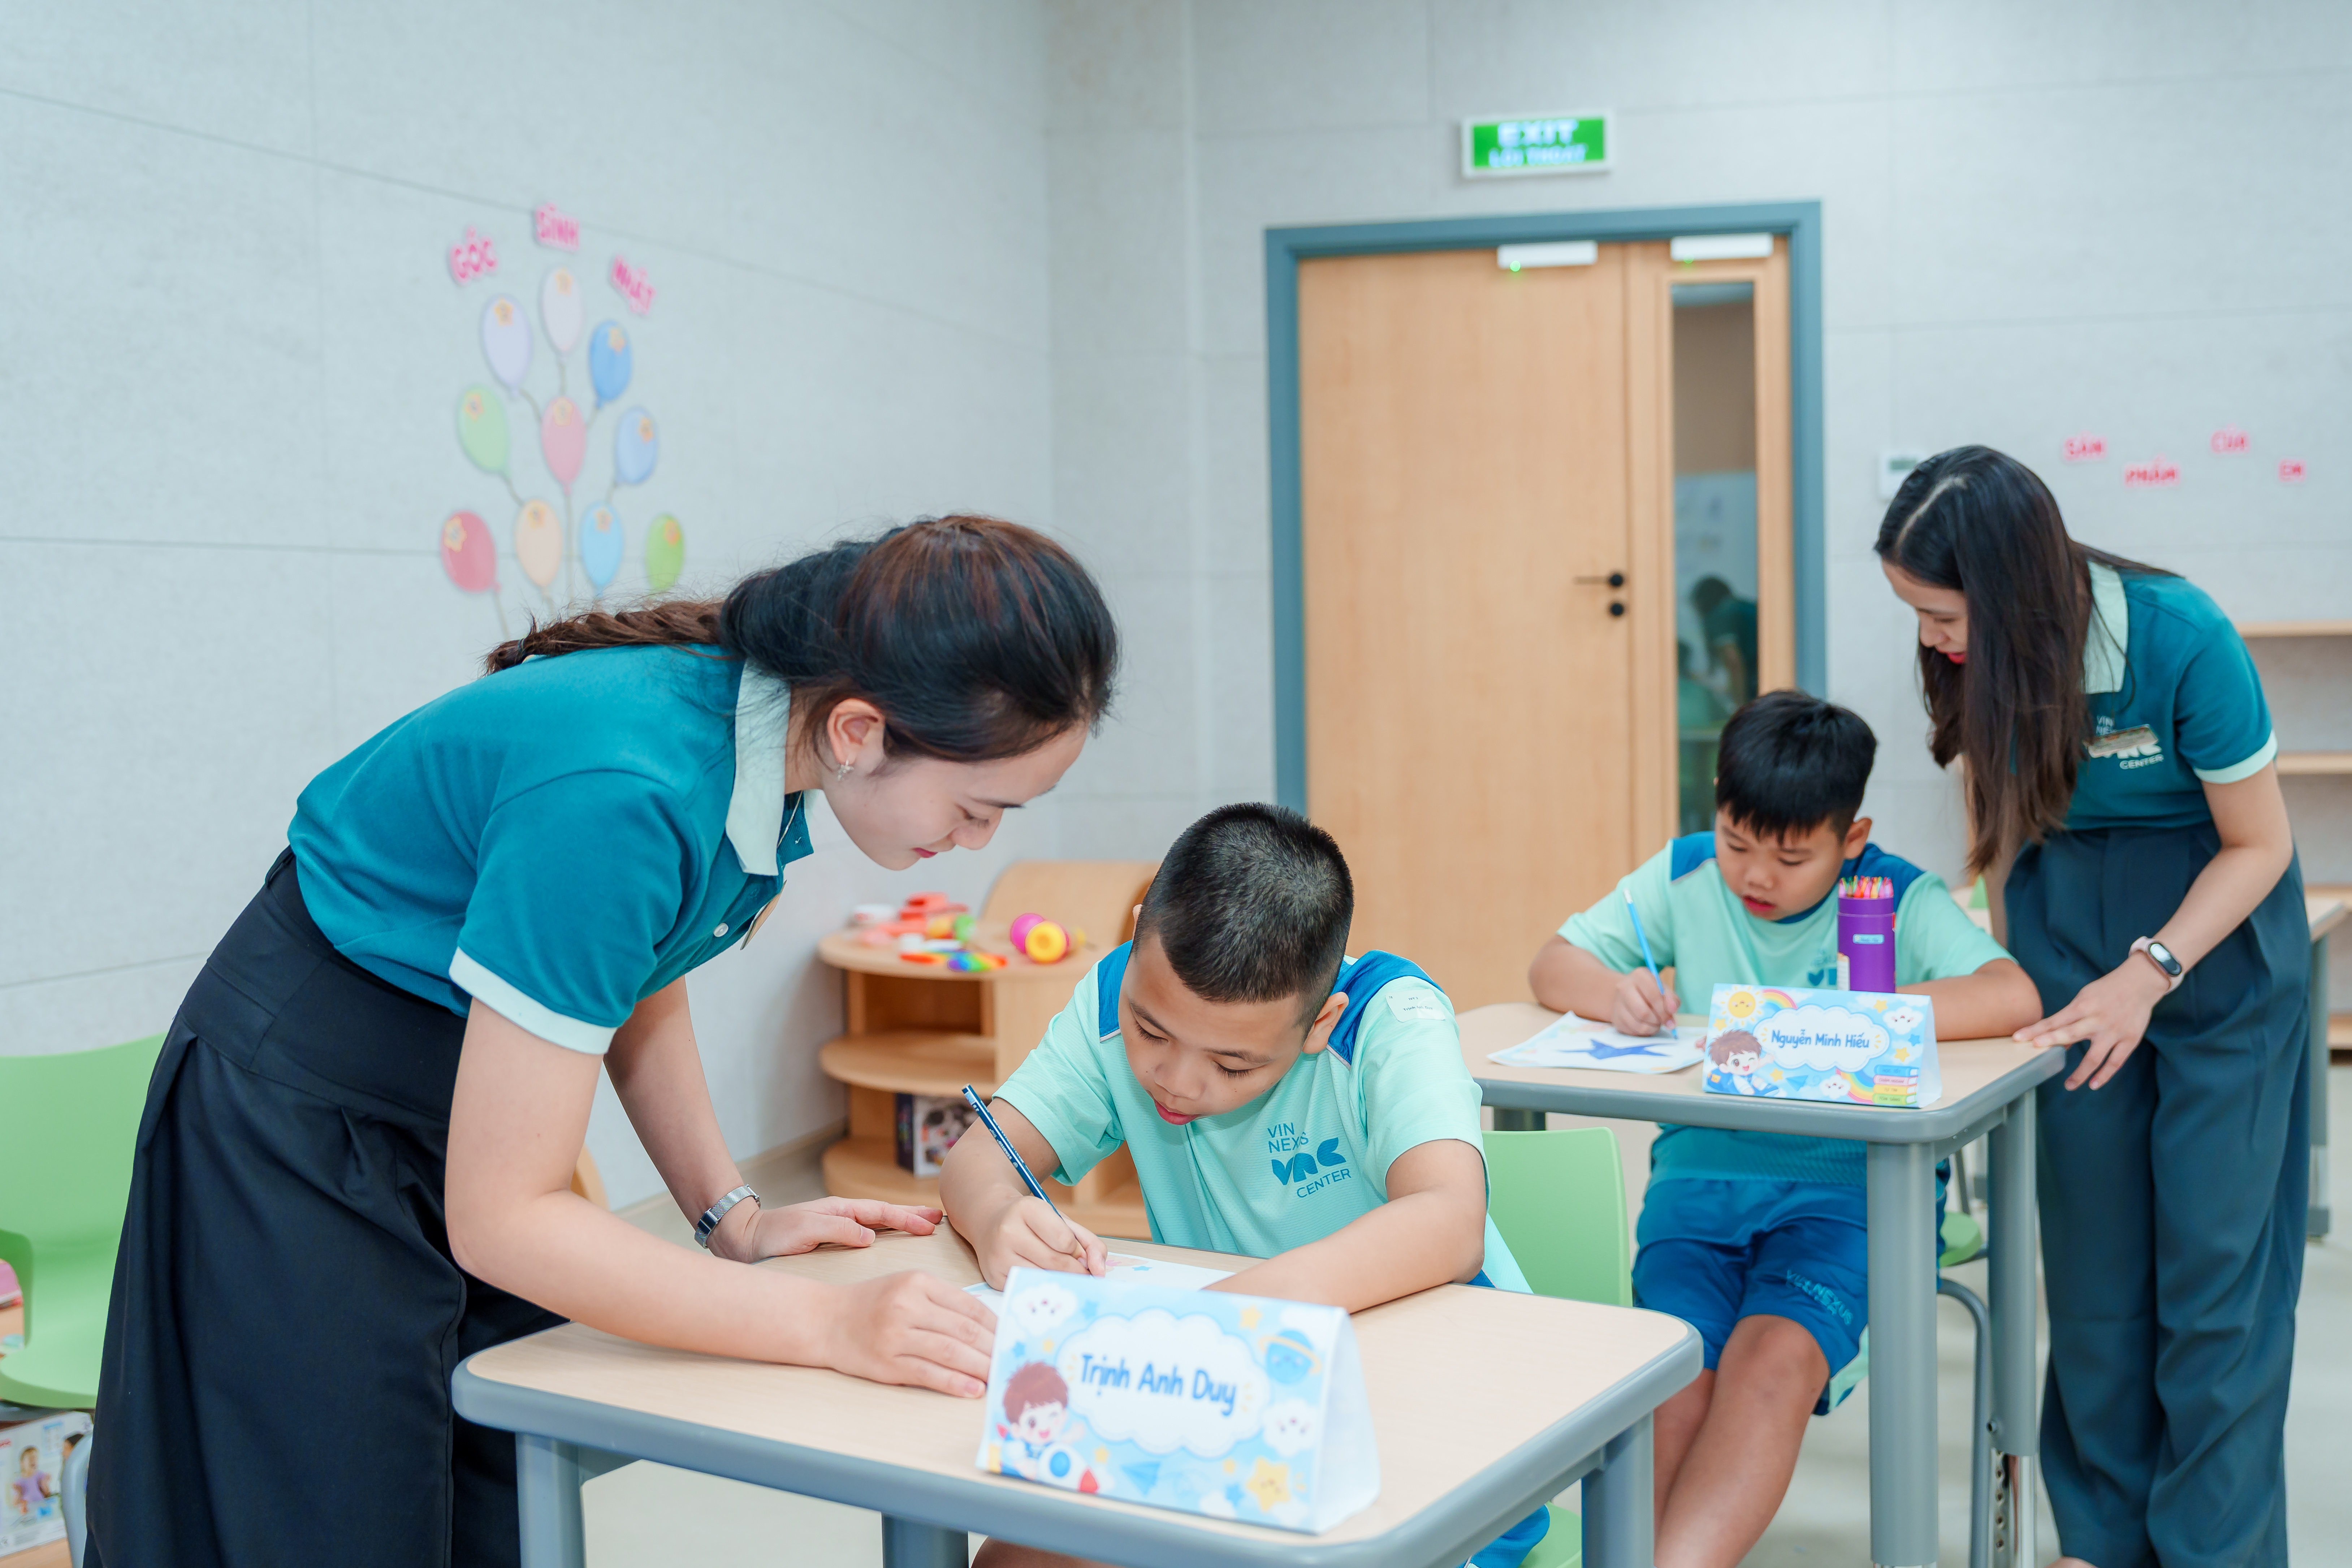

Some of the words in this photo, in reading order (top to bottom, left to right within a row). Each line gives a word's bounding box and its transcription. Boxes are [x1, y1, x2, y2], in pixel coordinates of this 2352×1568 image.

[1498, 119, 1579, 146] EXIT
[2119, 754, 2164, 770] CENTER
[1771, 1029, 1811, 1049] Nguyễn
[1815, 1033, 1841, 1046] Minh
[1845, 1032, 1869, 1048] Hiếu
[1267, 1122, 1294, 1138] VIN
[1297, 1169, 1351, 1198] CENTER
[1082, 1355, 1130, 1396] Trịnh
[1137, 1363, 1183, 1396] Anh
[1192, 1369, 1236, 1416] Duy
